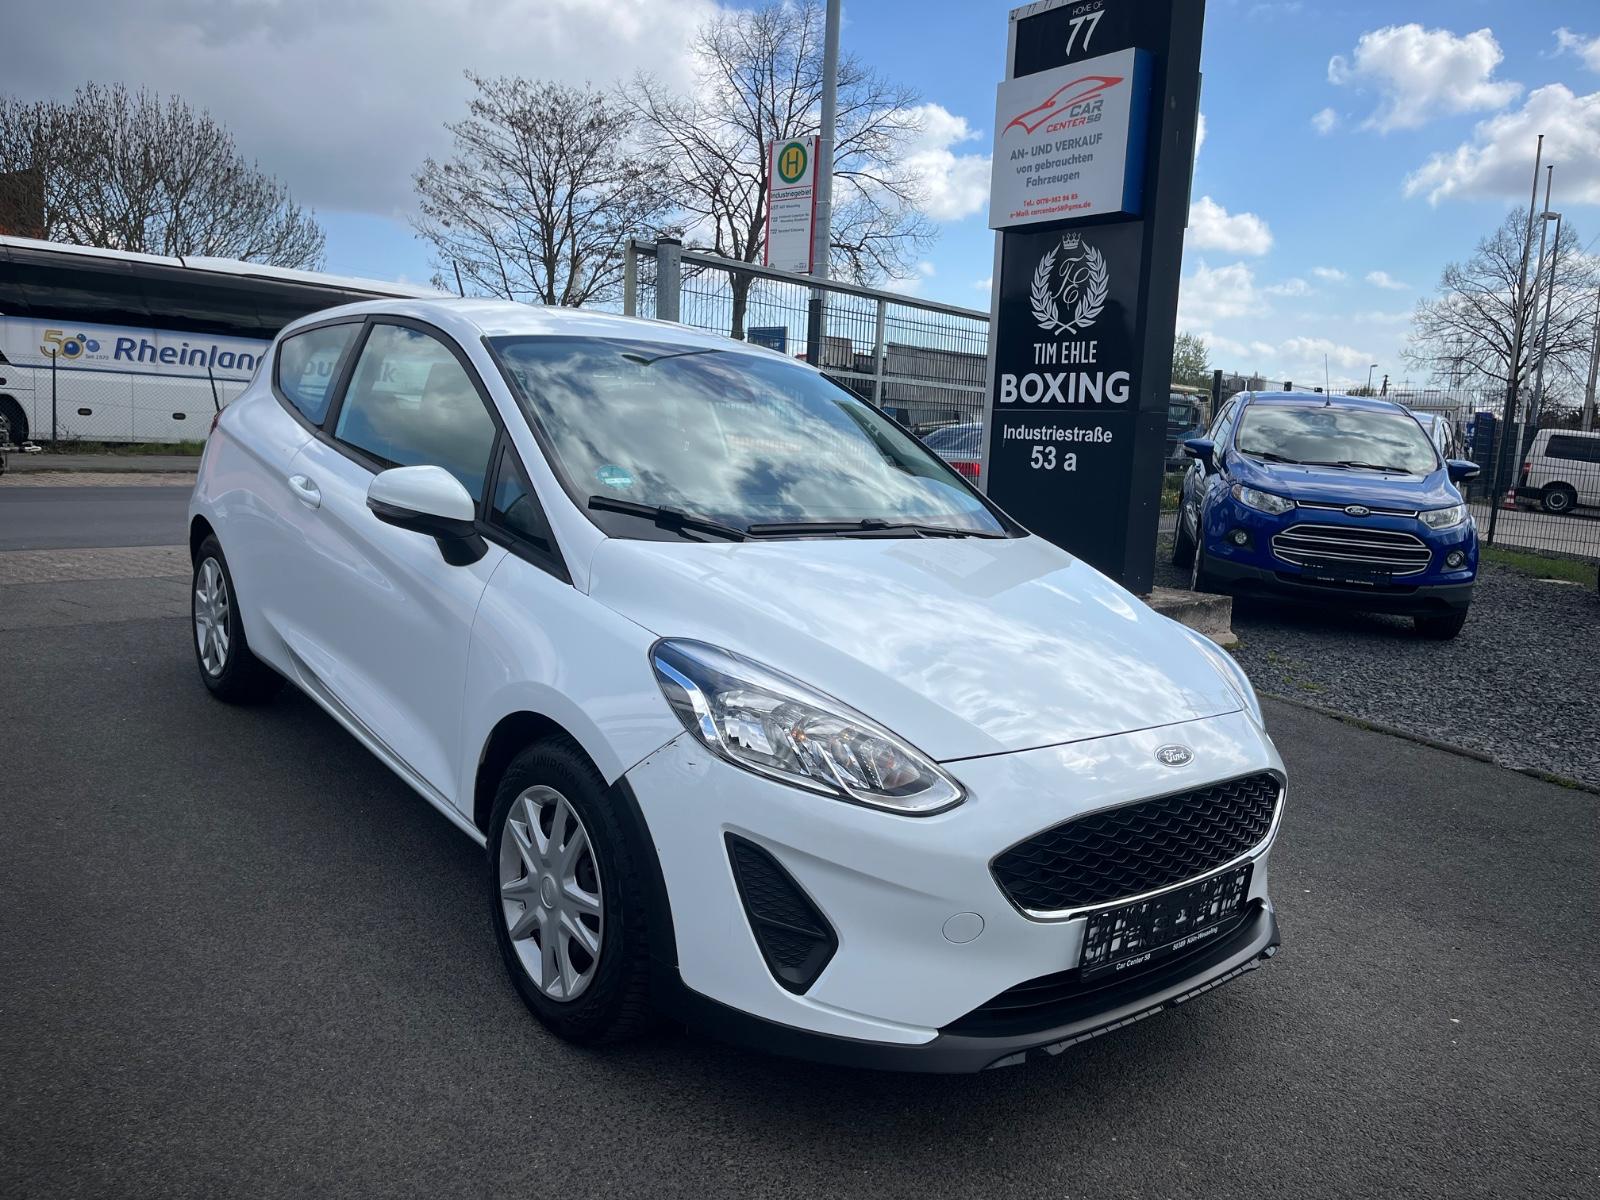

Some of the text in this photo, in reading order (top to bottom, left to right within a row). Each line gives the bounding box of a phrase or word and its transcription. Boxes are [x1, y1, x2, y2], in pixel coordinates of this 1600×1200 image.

[1072, 1, 1104, 16] HOME OF
[1065, 9, 1106, 57] 77
[1069, 99, 1105, 118] CAR
[786, 137, 813, 175] H A
[1010, 133, 1103, 161] AN- UND VERKAUF
[1016, 153, 1094, 175] von gebrauchten
[1026, 171, 1080, 188] Fahrzeugen
[770, 189, 812, 199] Industriegebiet
[1033, 340, 1097, 365] TIM EHLE
[1000, 371, 1130, 404] BOXING
[1003, 424, 1113, 443] Industriestraße
[1030, 445, 1077, 471] 53 a
[1164, 748, 1187, 763] Ford
[1116, 962, 1126, 971] Car
[1126, 956, 1143, 967] Center
